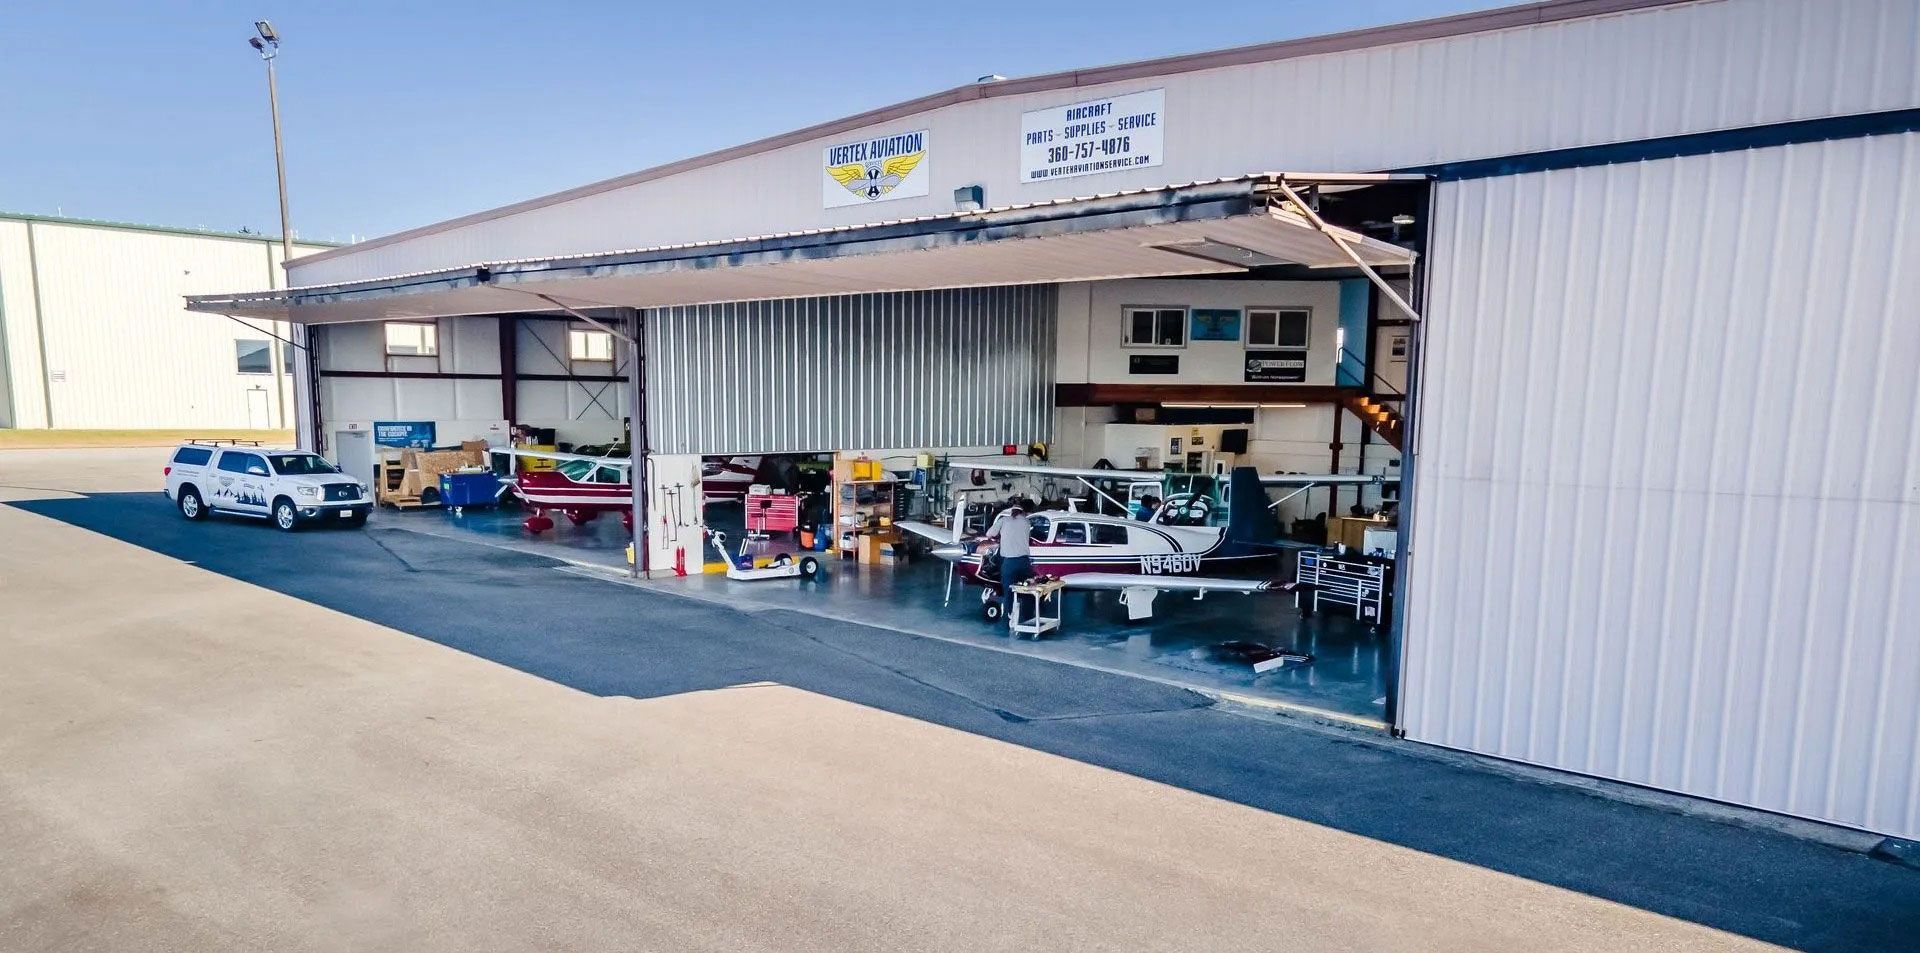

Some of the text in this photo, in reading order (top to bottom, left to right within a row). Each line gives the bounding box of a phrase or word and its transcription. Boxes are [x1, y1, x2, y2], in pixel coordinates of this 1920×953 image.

[1066, 103, 1112, 121] AIRCRAFT
[1027, 113, 1156, 145] PARTS SUPPLIES SERVICE
[830, 133, 922, 166] VERTEX AVIATION
[1048, 136, 1130, 163] 360-757-4876
[1140, 554, 1201, 575] N9460V
